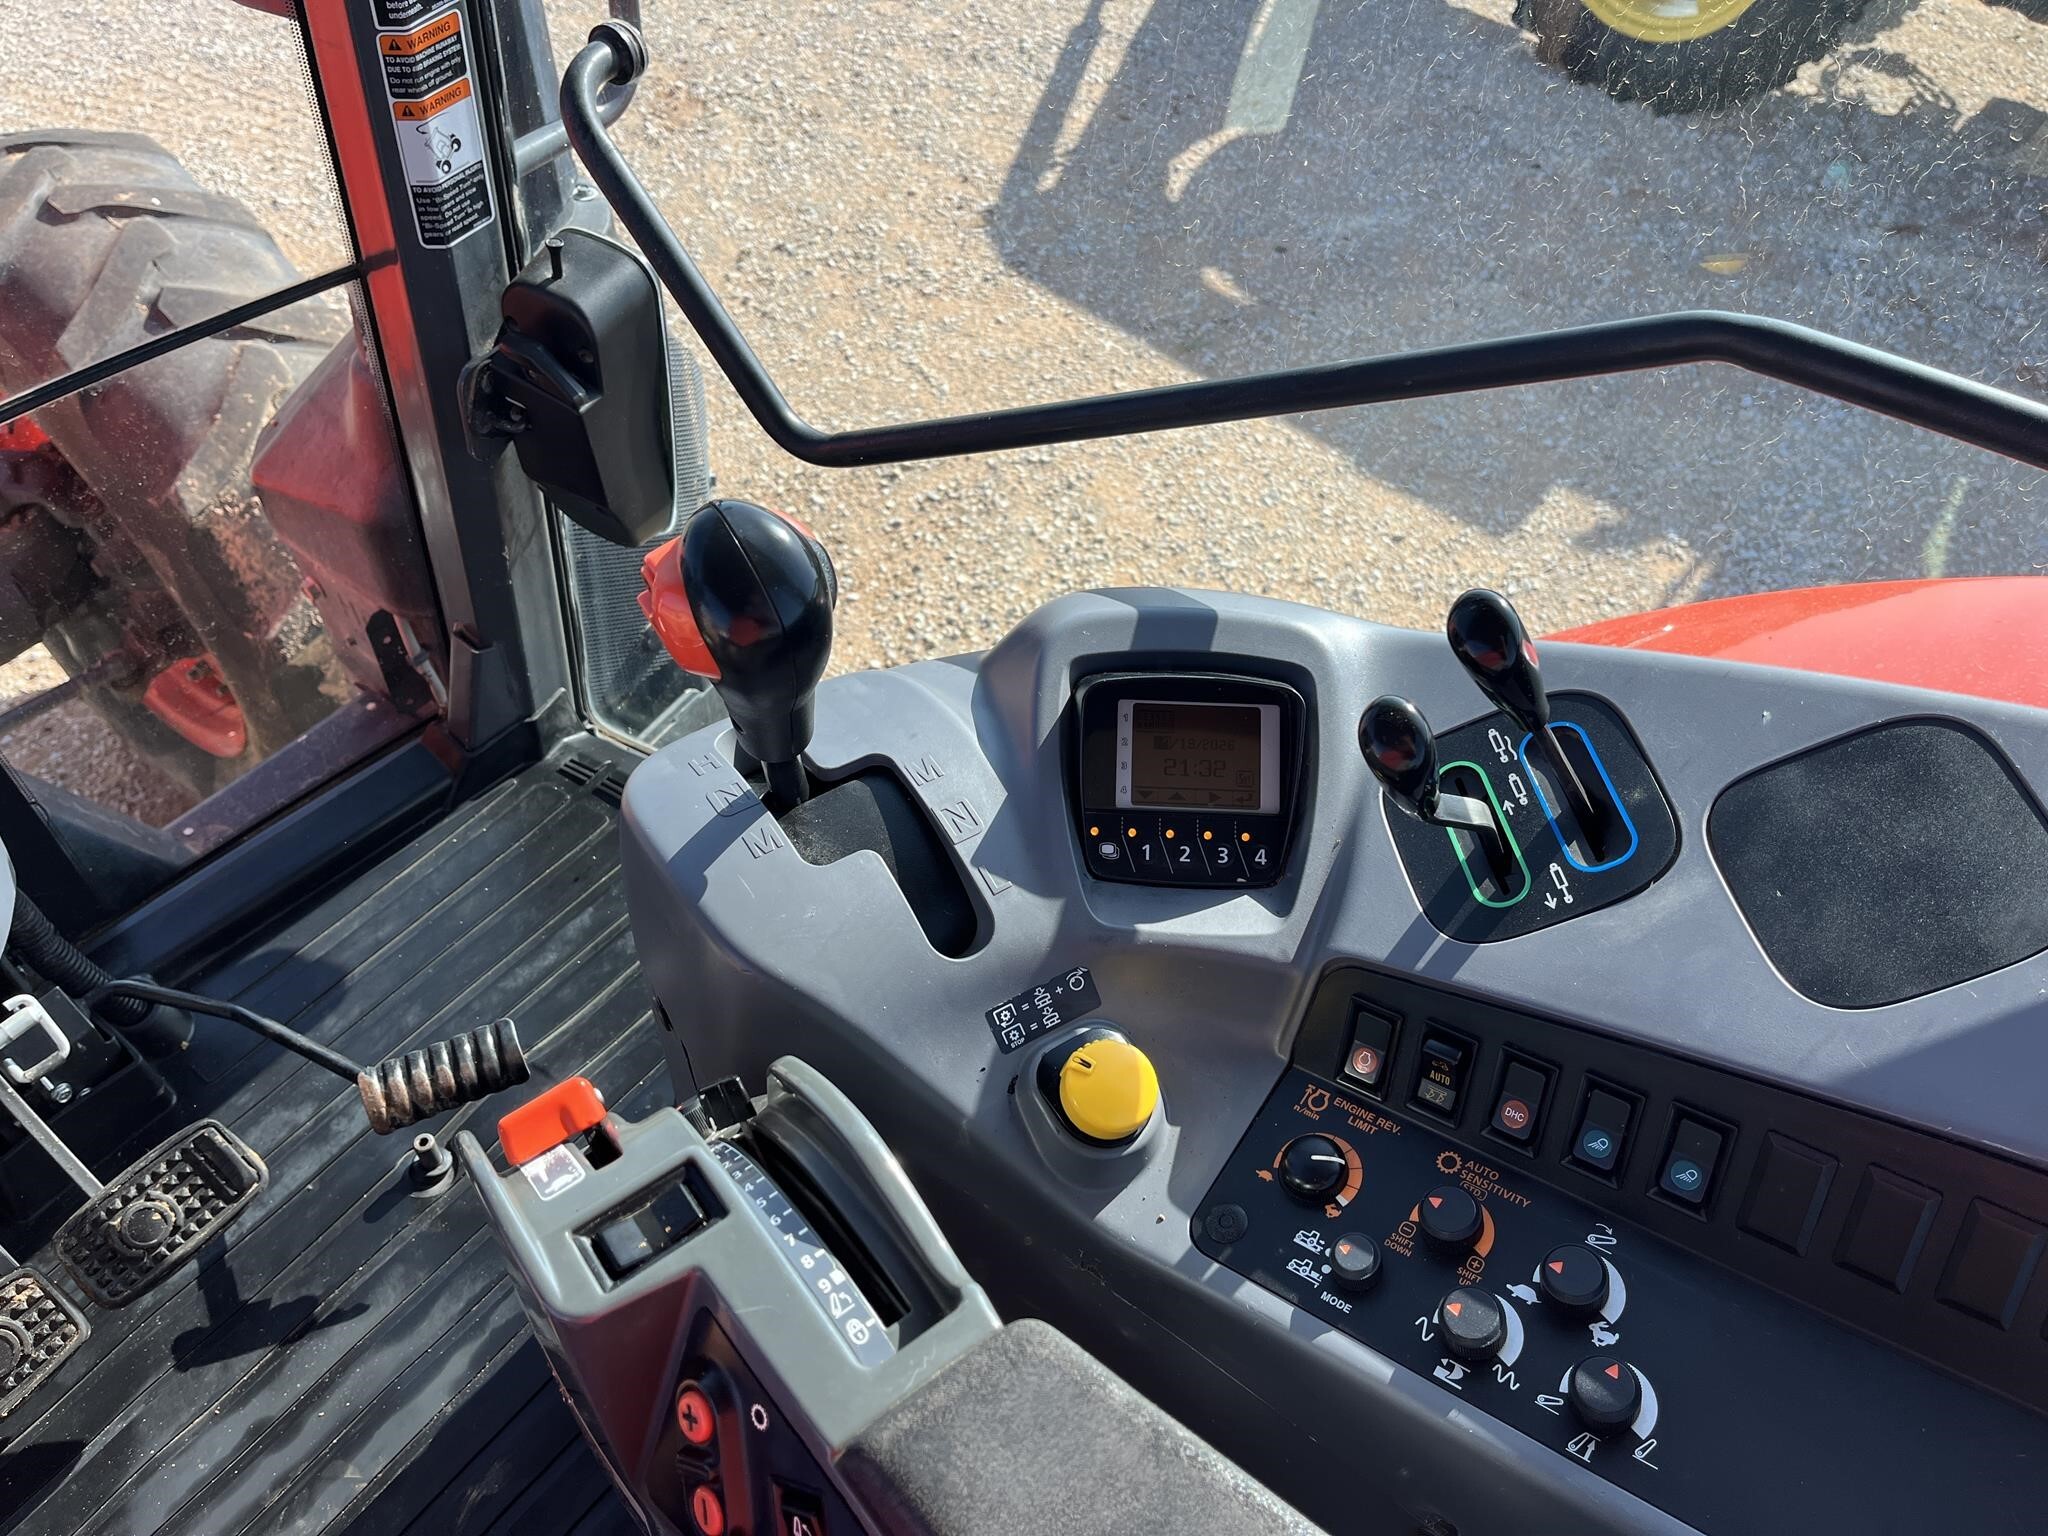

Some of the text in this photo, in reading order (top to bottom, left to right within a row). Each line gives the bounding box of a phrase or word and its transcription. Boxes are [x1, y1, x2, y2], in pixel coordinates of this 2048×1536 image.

[407, 21, 451, 50] WARNING
[418, 87, 461, 116] WARNING
[687, 751, 722, 776] H
[904, 754, 944, 787] M
[1163, 758, 1226, 778] 21:32
[714, 782, 751, 814] N
[940, 801, 979, 834] N
[742, 825, 784, 859] M
[1141, 844, 1267, 865] 1 2 3 4
[978, 865, 1013, 896] L
[1010, 1037, 1025, 1049] STOP
[1430, 1069, 1451, 1086] AUTO
[1293, 1104, 1321, 1121] n/min
[1333, 1097, 1377, 1122] ENGINE
[1504, 1107, 1525, 1122] DHC
[1347, 1116, 1378, 1135] LIMIT
[732, 1170, 743, 1180] 3
[1464, 1160, 1499, 1181] AUTO
[744, 1183, 755, 1192] 4
[1459, 1170, 1531, 1208] SENSITIVITY
[756, 1197, 767, 1209] 5
[769, 1214, 782, 1227] 6
[783, 1232, 796, 1247] 7
[1384, 1239, 1412, 1257] DOWN
[1390, 1232, 1415, 1248] SHIFT
[800, 1254, 815, 1270] 8
[1457, 1266, 1482, 1283] SHIFT
[817, 1278, 832, 1294] 9
[1320, 1291, 1353, 1314] MODE
